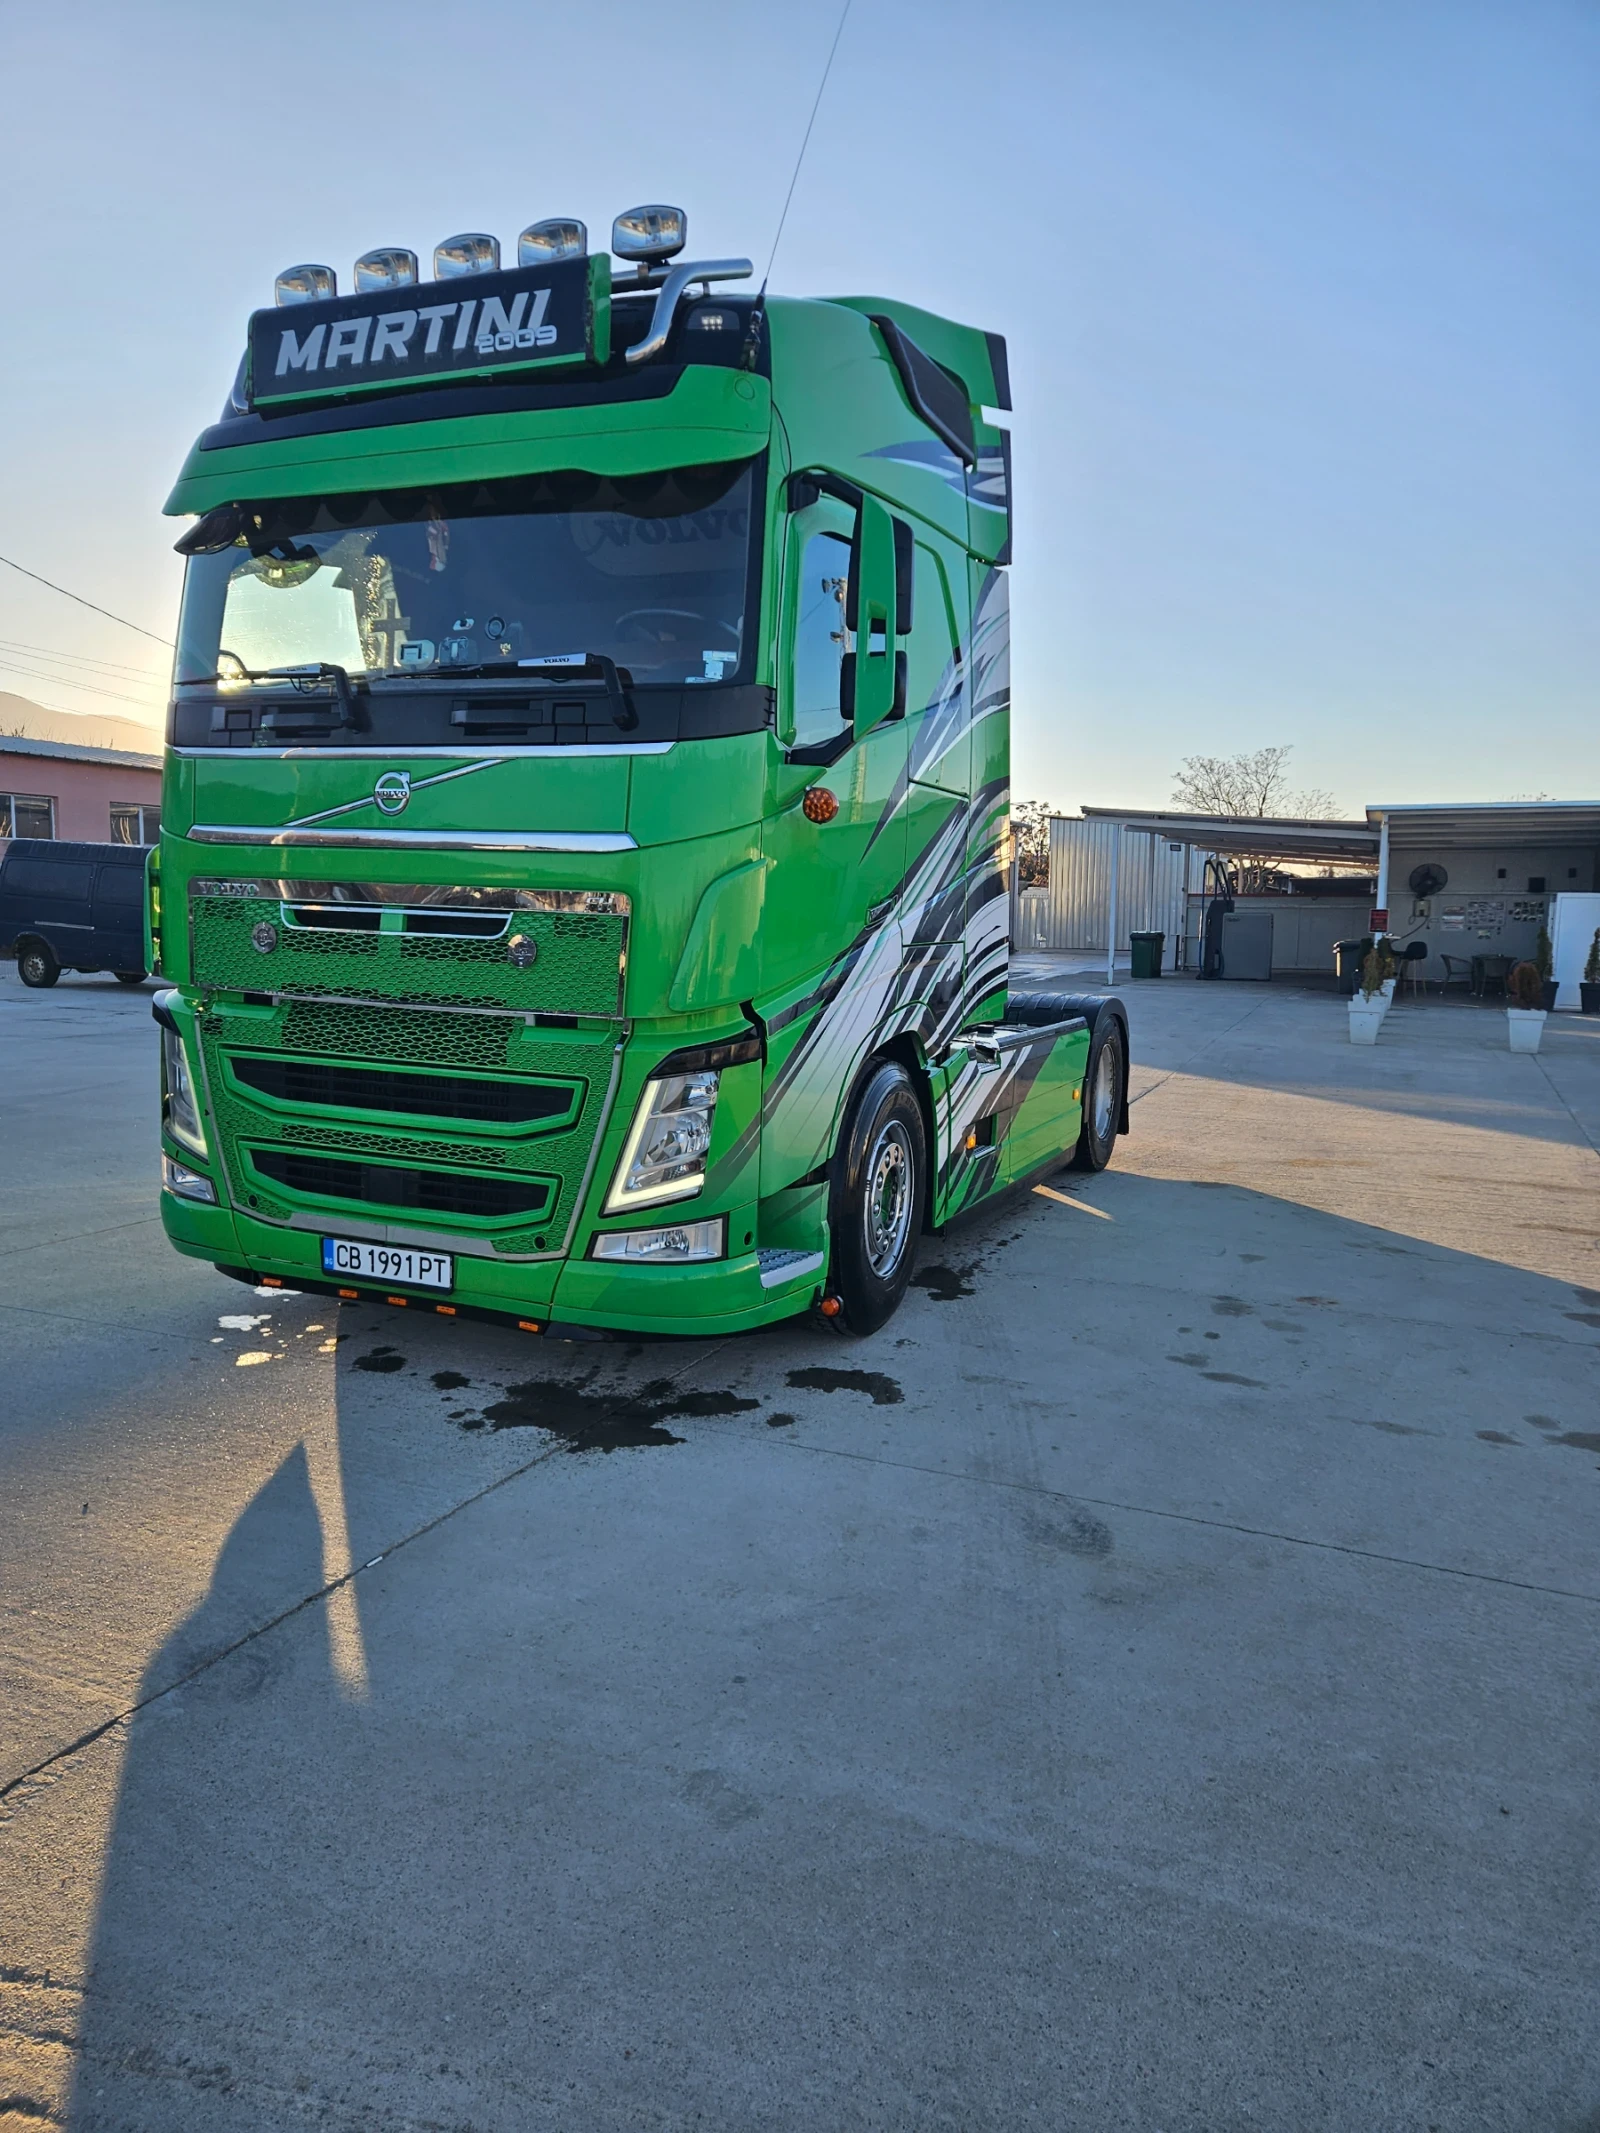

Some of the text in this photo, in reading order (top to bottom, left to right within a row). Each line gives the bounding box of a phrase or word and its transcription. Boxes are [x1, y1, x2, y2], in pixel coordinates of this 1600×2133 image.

[275, 289, 552, 376] MARTINI
[477, 324, 558, 354] 2009
[376, 790, 408, 798] VOLVO
[197, 881, 260, 897] VOLVO
[336, 1245, 446, 1283] CB 1991 PT
